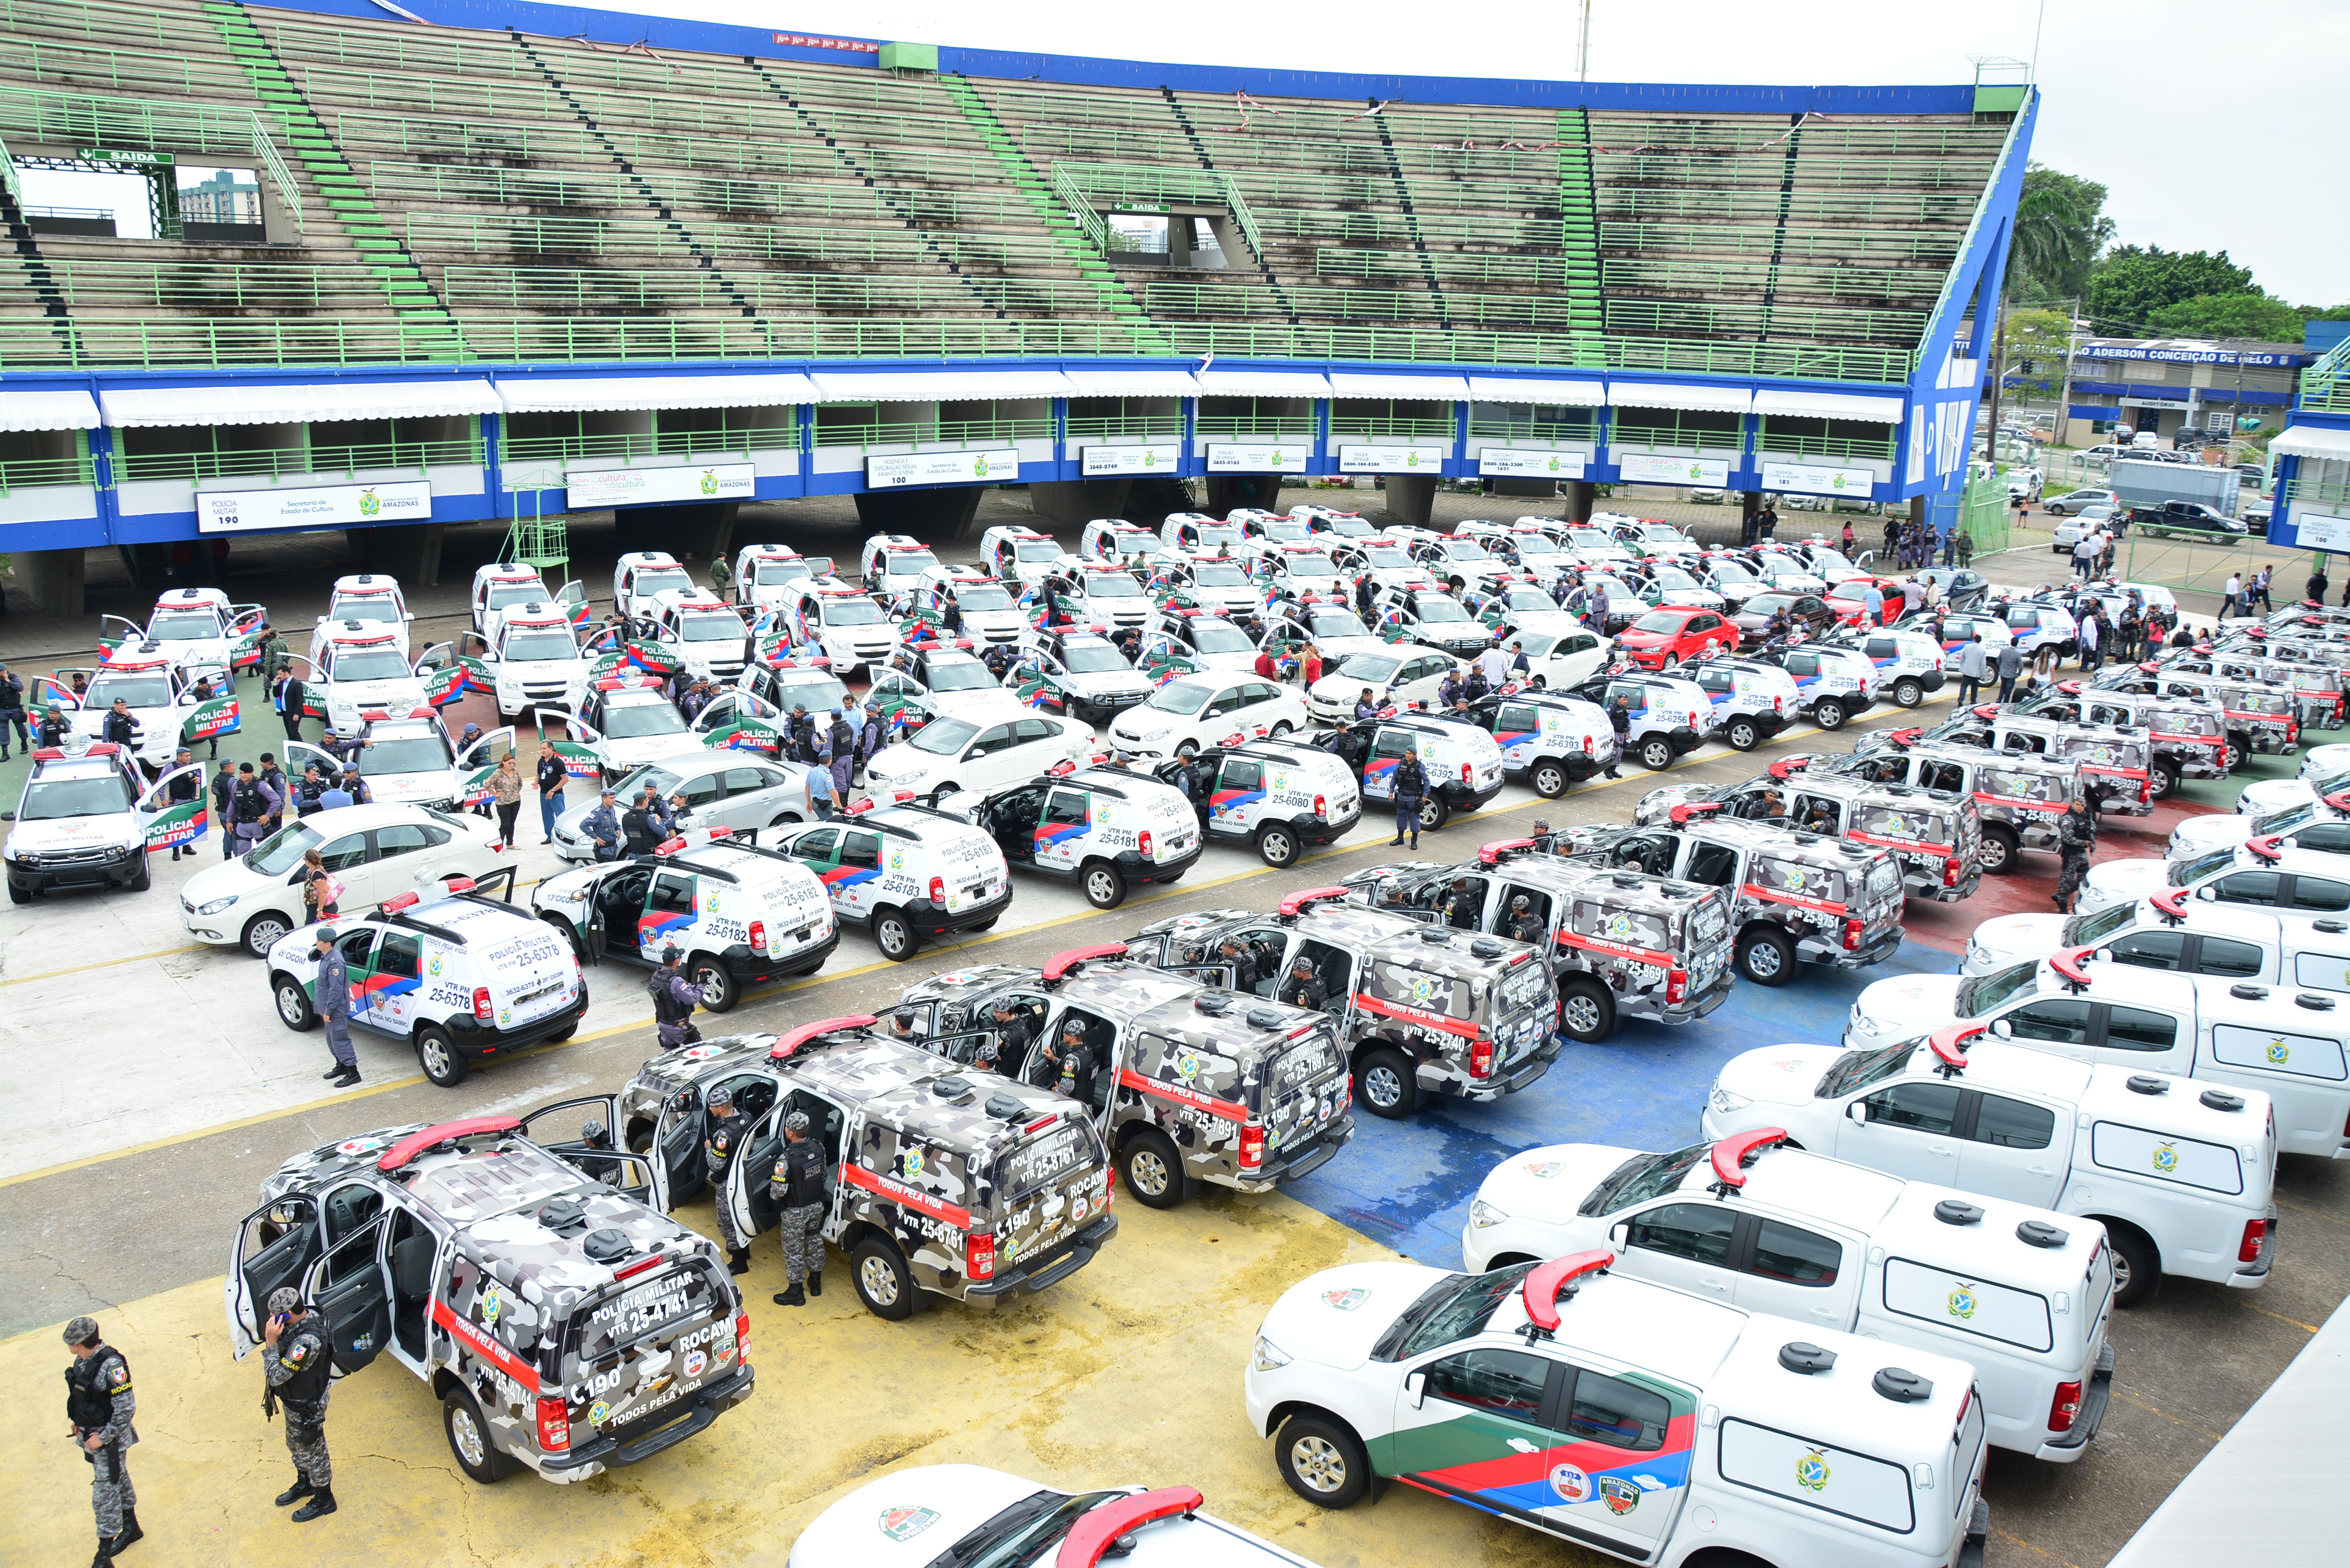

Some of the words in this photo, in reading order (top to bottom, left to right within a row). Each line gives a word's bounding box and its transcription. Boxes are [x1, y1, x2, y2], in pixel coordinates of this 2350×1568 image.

[837, 41, 849, 49] Real
[852, 42, 863, 51] Real
[2093, 348, 2145, 359] ADERSON
[2149, 349, 2216, 363] CONCEIÇÃO
[2219, 353, 2236, 363] DE
[598, 474, 626, 482] cultura
[618, 480, 644, 488] cultura
[642, 655, 674, 665] MILITAR
[1830, 681, 1858, 689] 25-6391
[1742, 698, 1772, 708] 25-6257
[194, 708, 233, 722] POLÍCIA
[1656, 714, 1687, 724] 25-6256
[195, 718, 234, 732] MILITAR
[1546, 739, 1579, 750] 25-6393
[2185, 743, 2213, 755] 25-2004
[2110, 777, 2142, 790] 25-9231
[1164, 802, 1188, 817] 25-6181
[1272, 794, 1309, 808] 25-6080
[2026, 809, 2059, 824] 25-9341
[146, 820, 195, 837] POLÍCIA
[147, 829, 195, 847] MILITAR
[966, 837, 987, 848] MILITAR
[1099, 833, 1136, 848] 25-6181
[962, 844, 993, 862] 25-6183
[1909, 852, 1944, 869] 25-6971
[789, 879, 813, 892] MILITAR
[882, 879, 920, 897] 25-6183
[784, 887, 819, 907] 25-6182
[1767, 888, 1787, 898] TODOS
[1788, 892, 1805, 902] PELA
[1806, 896, 1822, 906] VIDA
[716, 917, 728, 926] VTR
[1790, 909, 1802, 918] VTR
[1803, 910, 1839, 929] 25-9751
[522, 935, 552, 949] MILITAR
[705, 924, 747, 942] 25-6182
[516, 944, 559, 966] 25-6378
[1585, 936, 1608, 948] TODOS
[1609, 942, 1627, 952] PELA
[1629, 946, 1645, 956] VIDA
[1523, 964, 1542, 983] MILITAR
[1613, 960, 1627, 970] VTR
[1628, 960, 1667, 982] 25-8691
[445, 981, 458, 992] VTR
[459, 985, 470, 994] PM
[505, 981, 535, 996] 3632-6378
[429, 988, 470, 1010] 25-6378
[1383, 1000, 1407, 1014] TODOS
[1408, 1007, 1426, 1019] PELA
[1428, 1012, 1445, 1024] VIDA
[1535, 1000, 1556, 1020] ROCAM
[1409, 1025, 1423, 1037] VTR
[1423, 1027, 1465, 1052] 25-2740
[1302, 1038, 1327, 1058] MILITAR
[1284, 1071, 1296, 1083] VTR
[1295, 1051, 1326, 1081] 25-7891
[1147, 1078, 1172, 1092] TODOS
[1173, 1086, 1192, 1099] PELA
[1194, 1092, 1212, 1106] VIDA
[1319, 1074, 1346, 1098] ROCAM
[1179, 1109, 1194, 1122] VTR
[1195, 1111, 1238, 1140] 25-7891
[1281, 1138, 1299, 1155] TODOS
[1301, 1129, 1315, 1142] PELA
[1315, 1121, 1328, 1135] VIDA
[1010, 1147, 1044, 1171] POLÍCIA
[1045, 1128, 1078, 1153] MILITAR
[1020, 1169, 1035, 1183] VTR
[1035, 1143, 1076, 1180] 25-8761
[1069, 1168, 1105, 1199] ROCAM
[878, 1176, 903, 1194] TODOS
[903, 1185, 923, 1203] PELA
[925, 1195, 943, 1210] VIDA
[1005, 1209, 1030, 1234] 190
[904, 1214, 918, 1229] VTR
[921, 1217, 963, 1252] 25-8761
[1014, 1246, 1039, 1265] TODOS
[1040, 1237, 1059, 1251] PELA
[1060, 1225, 1077, 1240] VIDA
[592, 1293, 643, 1325] POLÍCIA
[644, 1271, 694, 1302] MILITAR
[606, 1321, 629, 1339] VTR
[629, 1289, 690, 1334] 25-4741
[456, 1316, 477, 1339] TODOS
[477, 1331, 494, 1352] PELA
[494, 1344, 511, 1364] VIDA
[679, 1317, 732, 1353] ROCAM
[480, 1363, 493, 1381] VTR
[496, 1369, 532, 1414] 25-4741
[585, 1368, 621, 1398] 190
[610, 1404, 647, 1427] TODOS
[649, 1391, 676, 1410] PELA
[678, 1378, 702, 1396] VIDA
[1603, 1478, 1639, 1495] AMAZONAS
